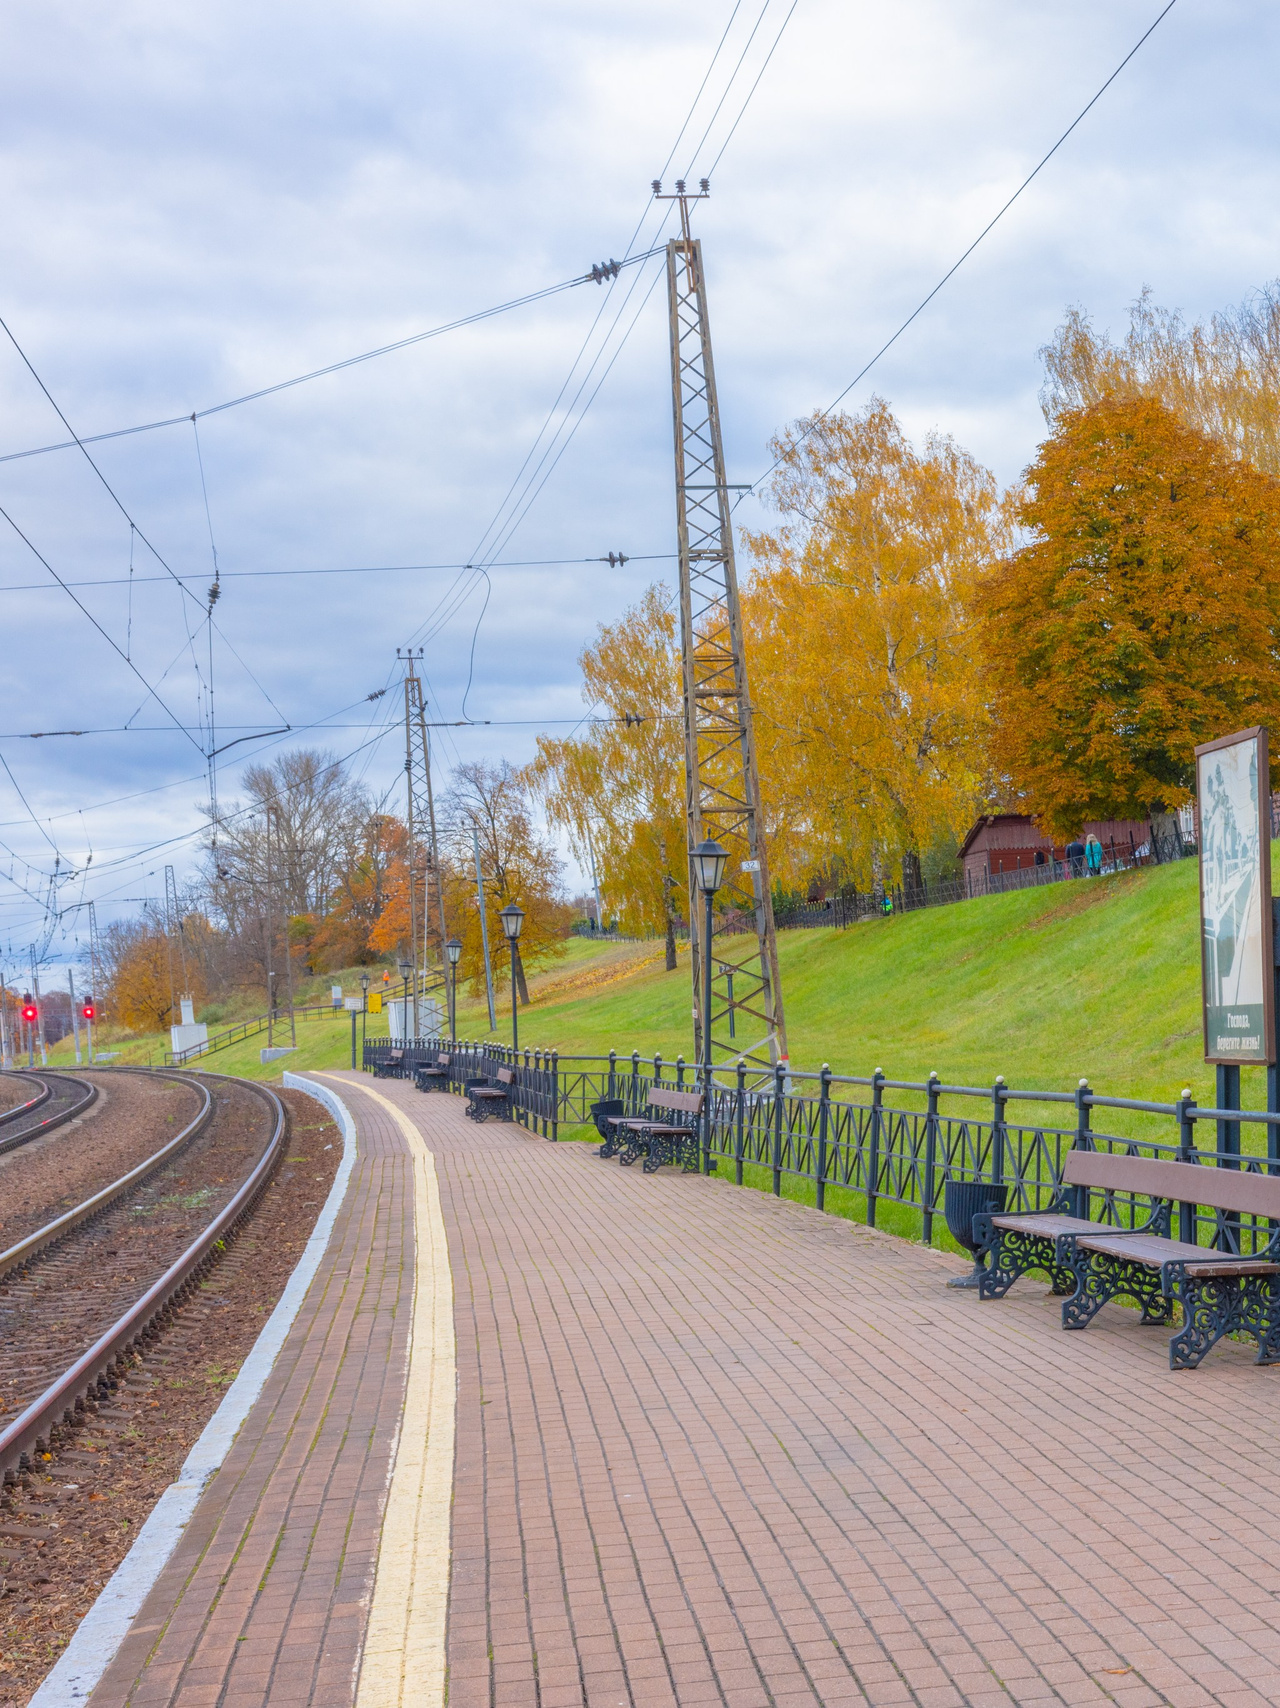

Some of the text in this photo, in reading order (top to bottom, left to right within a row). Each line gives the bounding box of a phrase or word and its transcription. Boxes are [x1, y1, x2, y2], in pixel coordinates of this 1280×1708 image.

[745, 861, 755, 869] 32
[1227, 1013, 1250, 1028] Господа,
[1217, 1035, 1260, 1051] берегите жизнь!
